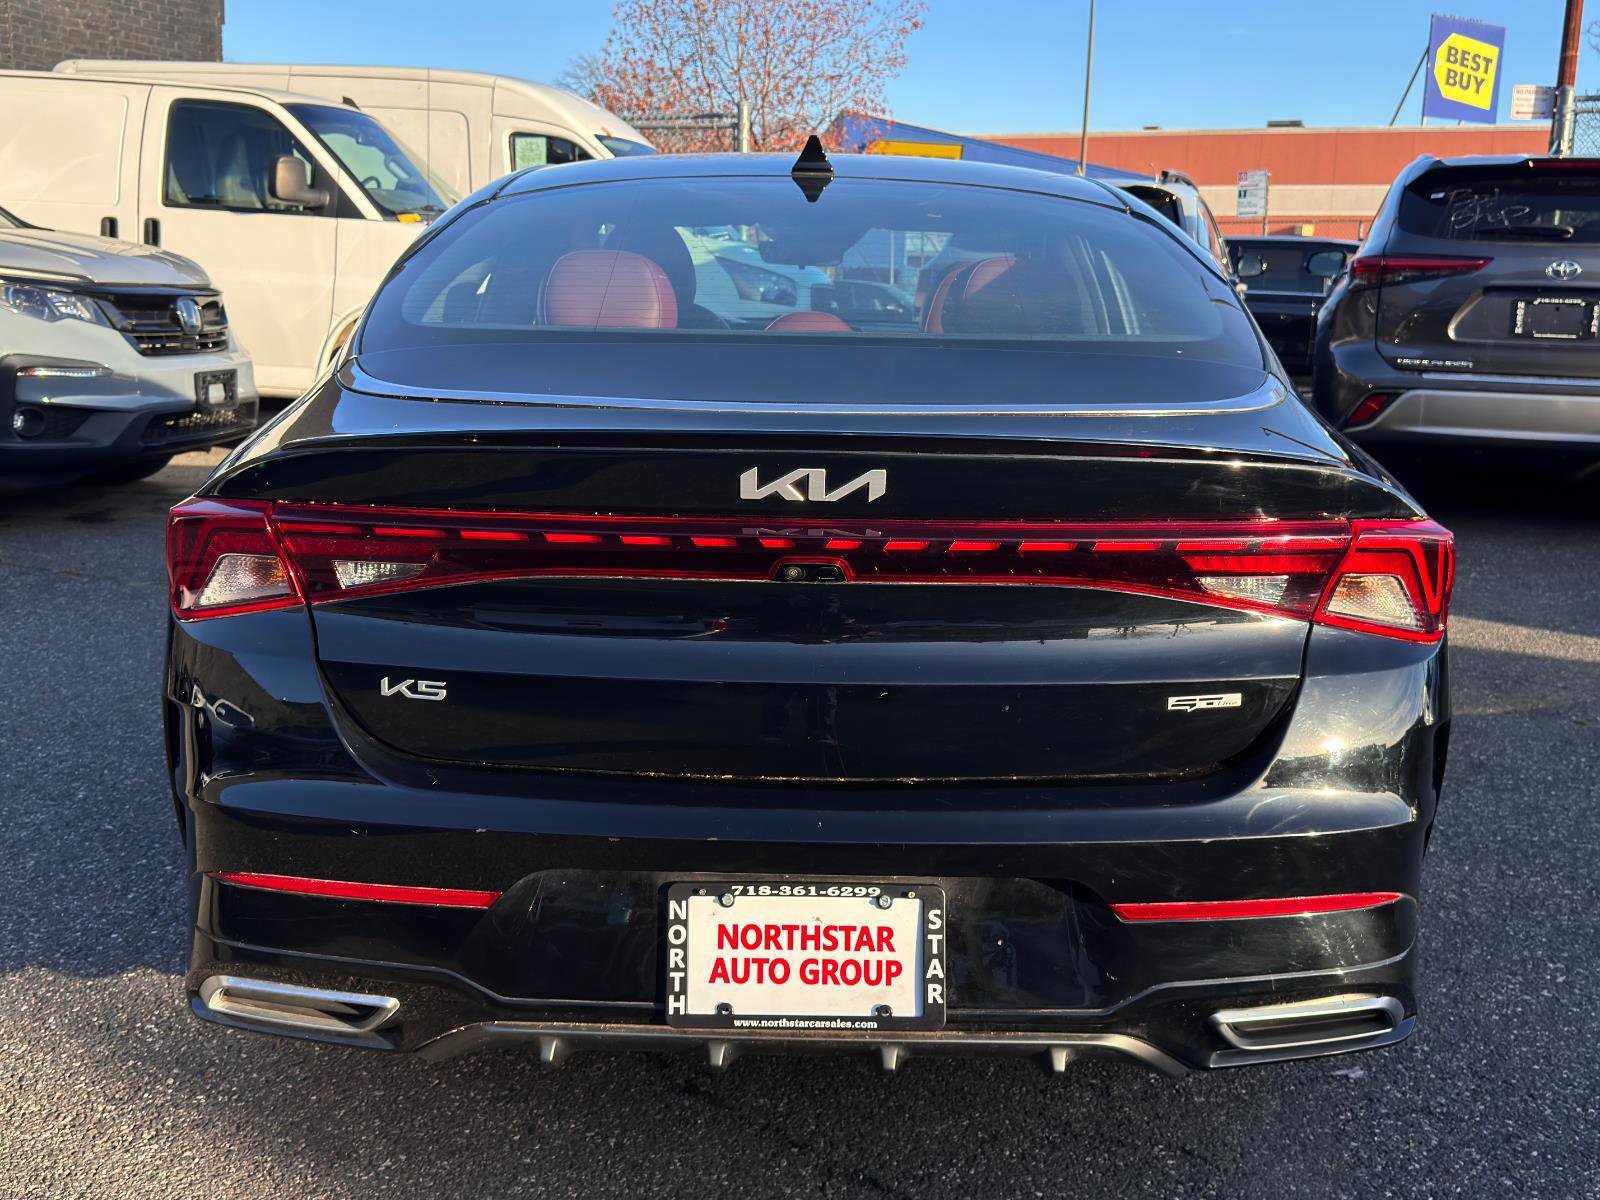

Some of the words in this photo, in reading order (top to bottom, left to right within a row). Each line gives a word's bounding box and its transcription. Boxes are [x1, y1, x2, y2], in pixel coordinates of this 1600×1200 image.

[1446, 45, 1493, 75] BEST
[1445, 68, 1486, 95] BUY
[740, 467, 886, 502] KIA
[381, 677, 446, 701] K5
[731, 885, 881, 897] 718-361-6299
[717, 923, 896, 952] NORTHSTAR
[668, 900, 687, 1015] NORTH
[927, 910, 944, 1004] STAR
[708, 958, 791, 984] AUTO
[799, 959, 903, 986] GROUP
[733, 1018, 878, 1029] www.northstarcarsales.com
